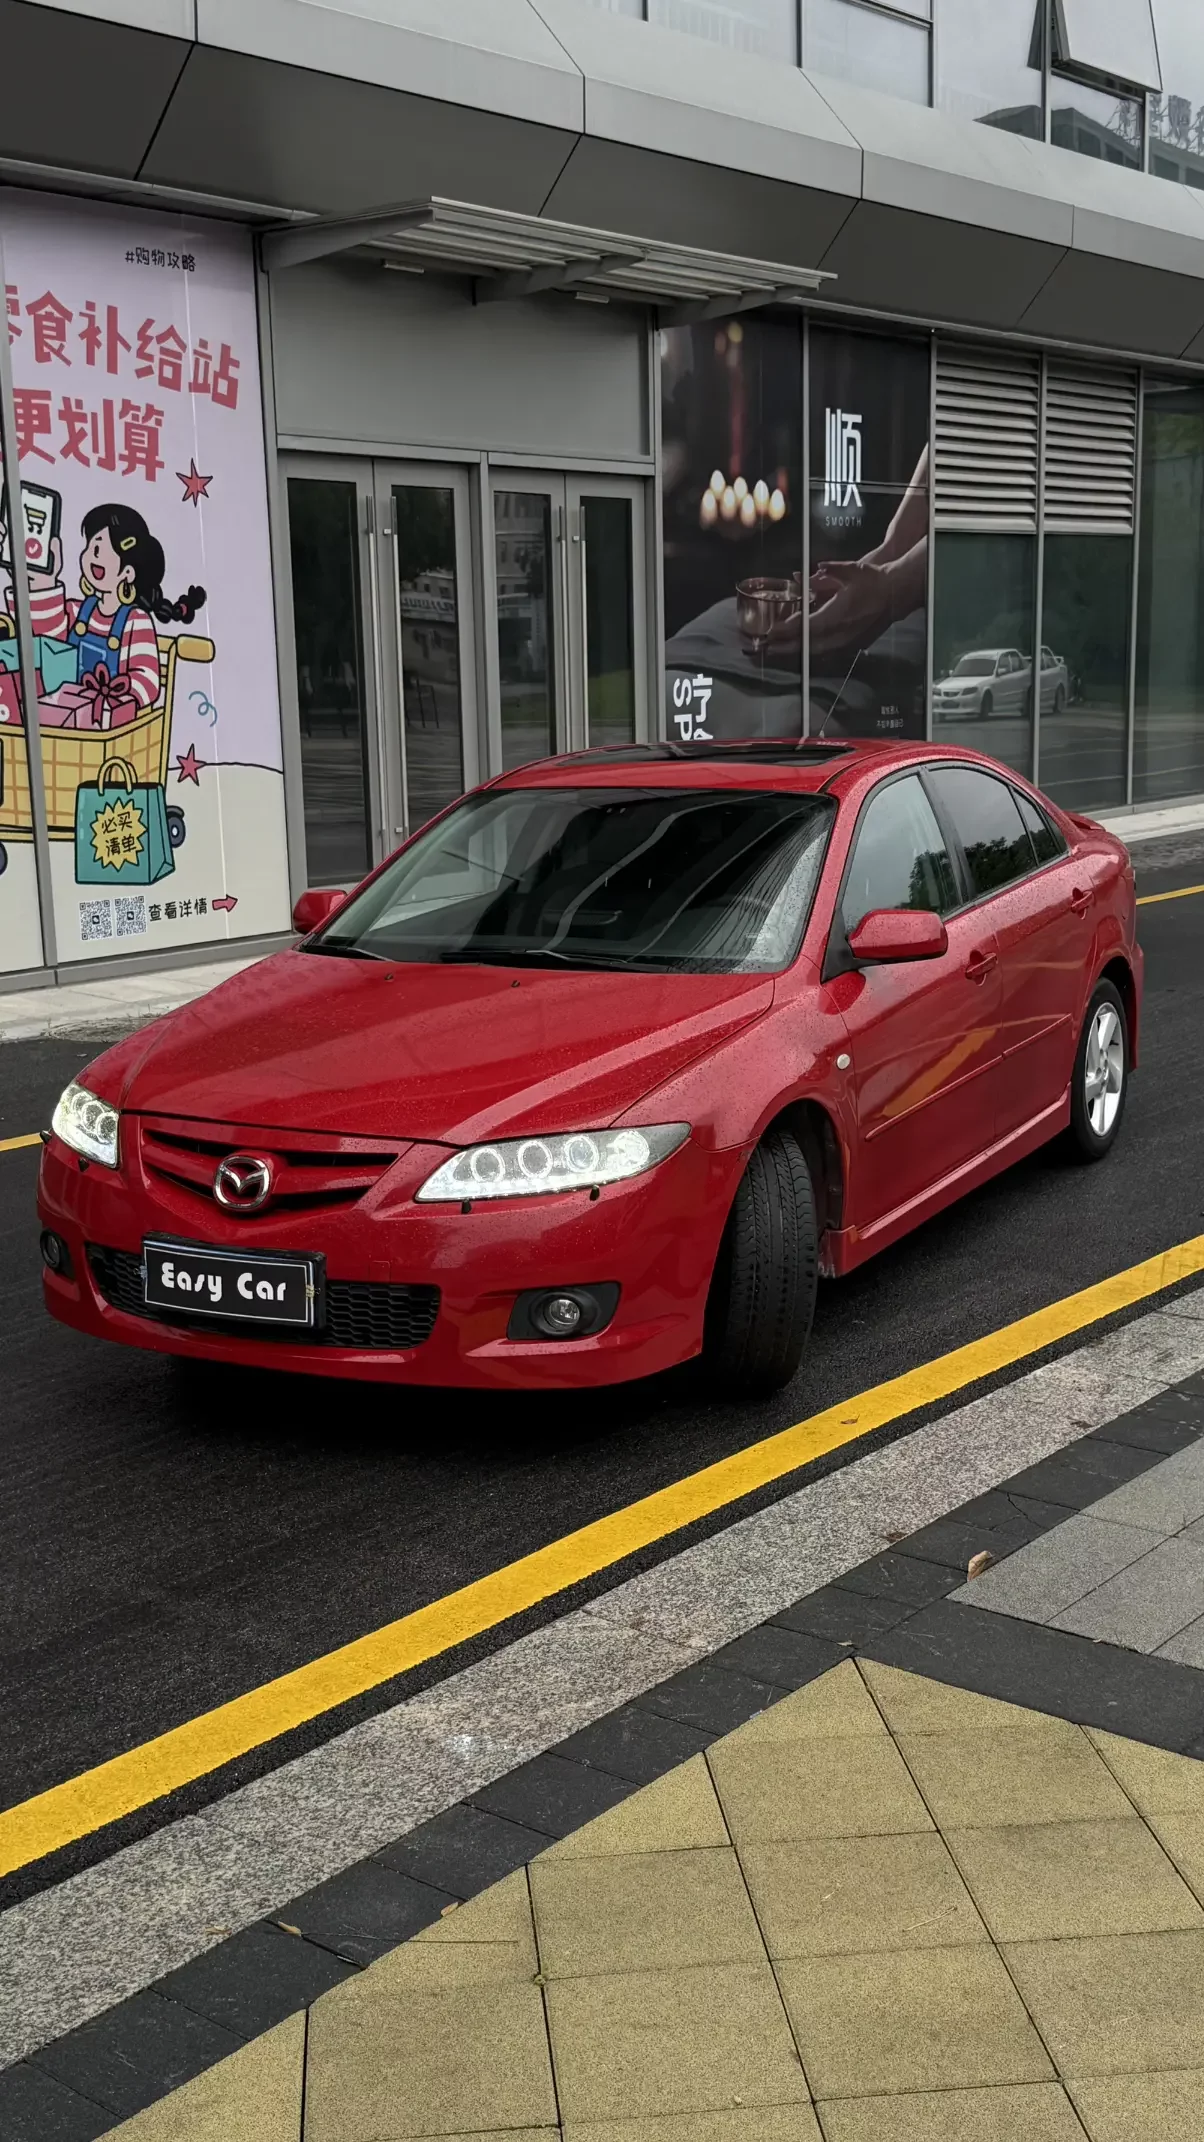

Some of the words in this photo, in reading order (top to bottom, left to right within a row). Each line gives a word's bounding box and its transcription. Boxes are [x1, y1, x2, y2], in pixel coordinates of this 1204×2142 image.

[125, 247, 197, 272] #购物攻略
[12, 387, 165, 483] 更划算
[823, 407, 863, 508] 顺
[825, 515, 862, 528] SMOOTH
[101, 811, 133, 834] 必买
[105, 833, 137, 858] 清单
[148, 897, 208, 922] 查看详情
[161, 1261, 223, 1303] Easy
[236, 1272, 286, 1302] Car
